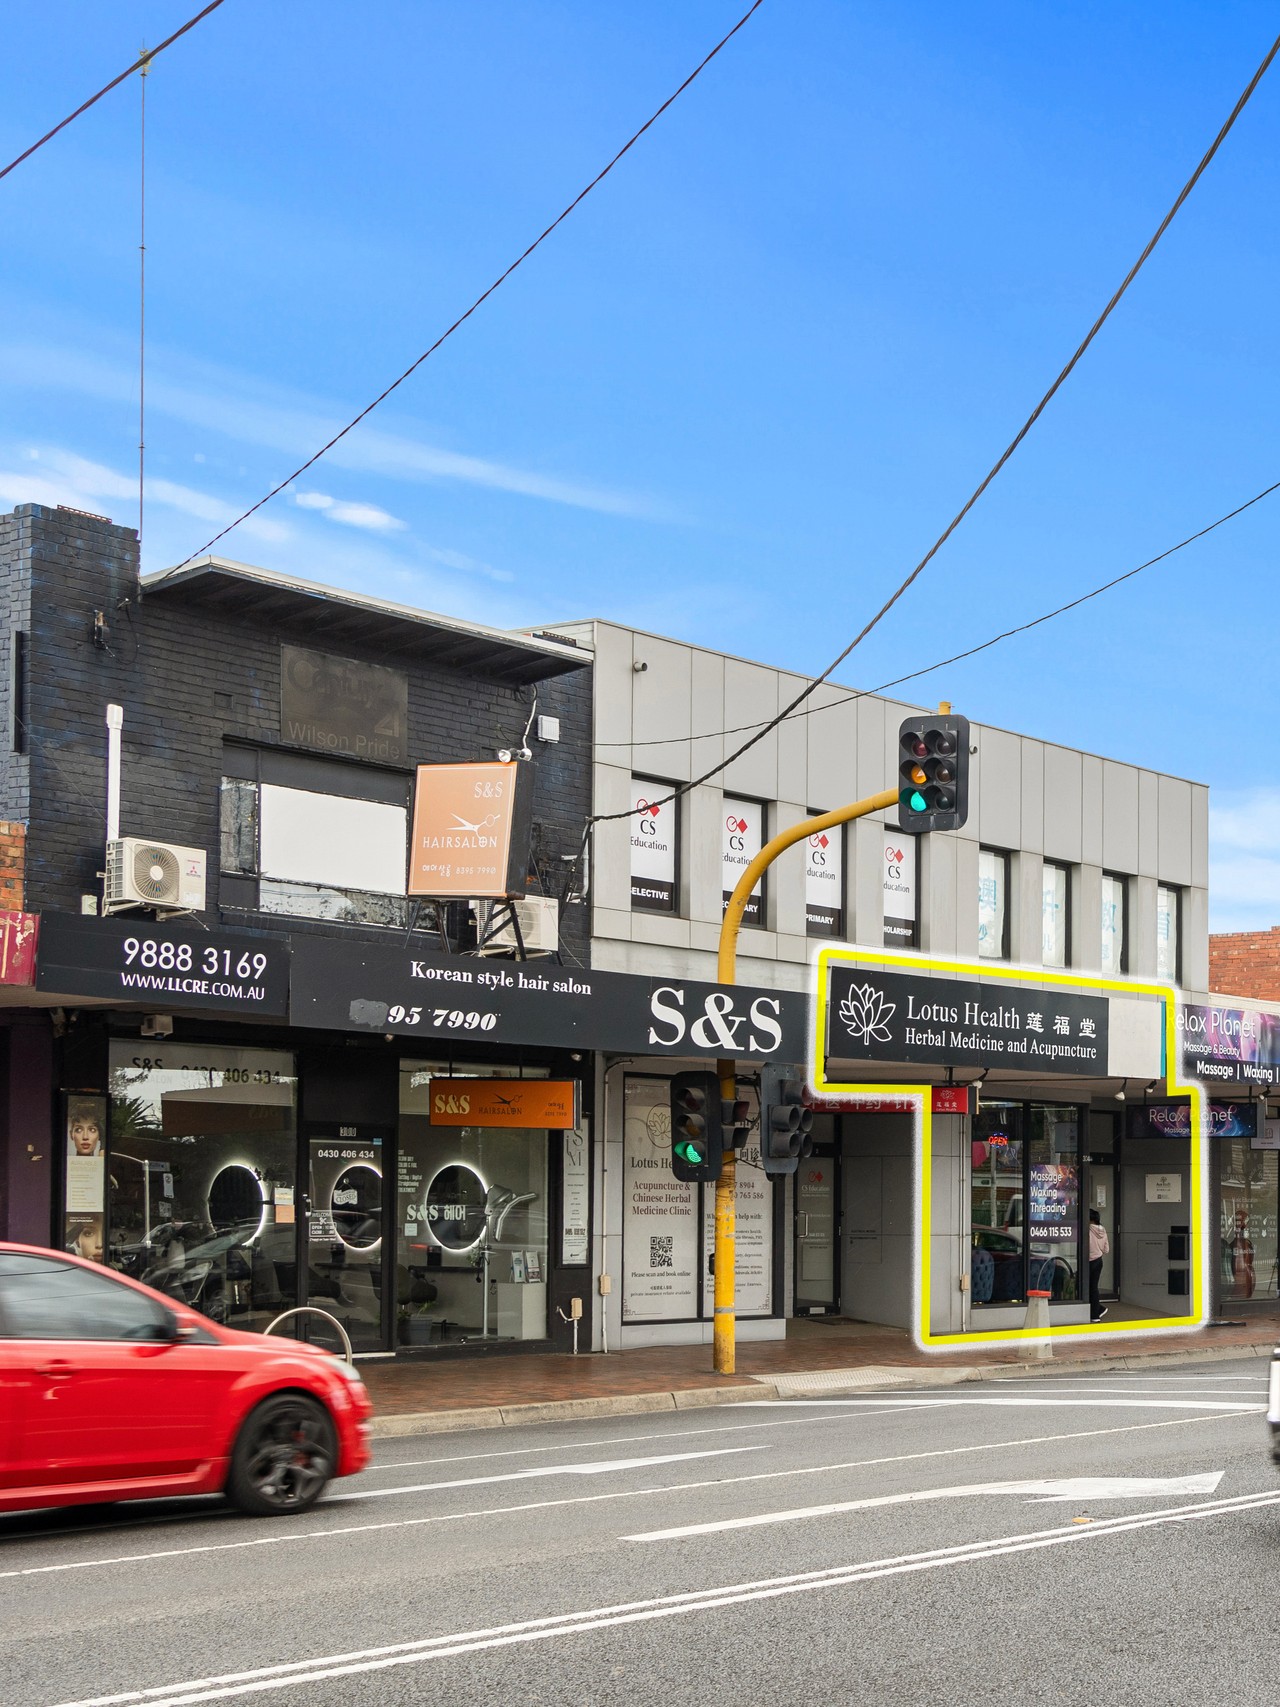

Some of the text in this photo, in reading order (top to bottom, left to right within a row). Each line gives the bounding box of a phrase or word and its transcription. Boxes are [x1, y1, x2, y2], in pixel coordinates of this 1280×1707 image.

[288, 720, 400, 760] Wilson Pride
[474, 781, 503, 799] S&S
[640, 819, 656, 835] CS
[422, 836, 498, 849] HAIRSALON
[729, 835, 744, 851] CS
[722, 852, 752, 865] ducatio
[812, 851, 826, 865] CS
[456, 867, 496, 875] 8395 7990
[806, 867, 836, 880] ducation
[888, 865, 901, 879] CS
[883, 881, 910, 893] ducation
[722, 901, 758, 913] ECARY
[124, 937, 267, 980] 9888 3169
[410, 960, 592, 995] Korean style hair salon
[121, 972, 265, 1000] WWW.LLCRE.COM.AU
[907, 995, 1020, 1029] Lotus Health
[432, 1009, 497, 1031] 7990
[648, 986, 783, 1054] S&S
[1212, 1011, 1256, 1038] Planet
[905, 1028, 1097, 1060] Herbal Medicine and Acupuncture
[1184, 1041, 1212, 1055] Massage
[1219, 1044, 1240, 1057] Beauty
[1197, 1061, 1233, 1077] Massage
[1243, 1065, 1273, 1083] Waxing
[435, 1094, 470, 1114] S&S
[1149, 1109, 1185, 1122] Relax
[1164, 1126, 1191, 1136] Massage
[988, 1136, 1008, 1146] OPEN
[318, 1150, 375, 1159] 0430 406 434
[631, 1157, 659, 1169] Lotus
[1030, 1171, 1063, 1184] Massage
[633, 1181, 691, 1192] Acupuncture &
[1030, 1187, 1058, 1199] Waxing
[633, 1193, 691, 1203] Chinese Herbal
[406, 1204, 466, 1221] S&S 헤어
[632, 1206, 692, 1216] Medicine Clinic
[1030, 1202, 1067, 1215] Threading
[1030, 1227, 1072, 1237] 0466 115 533
